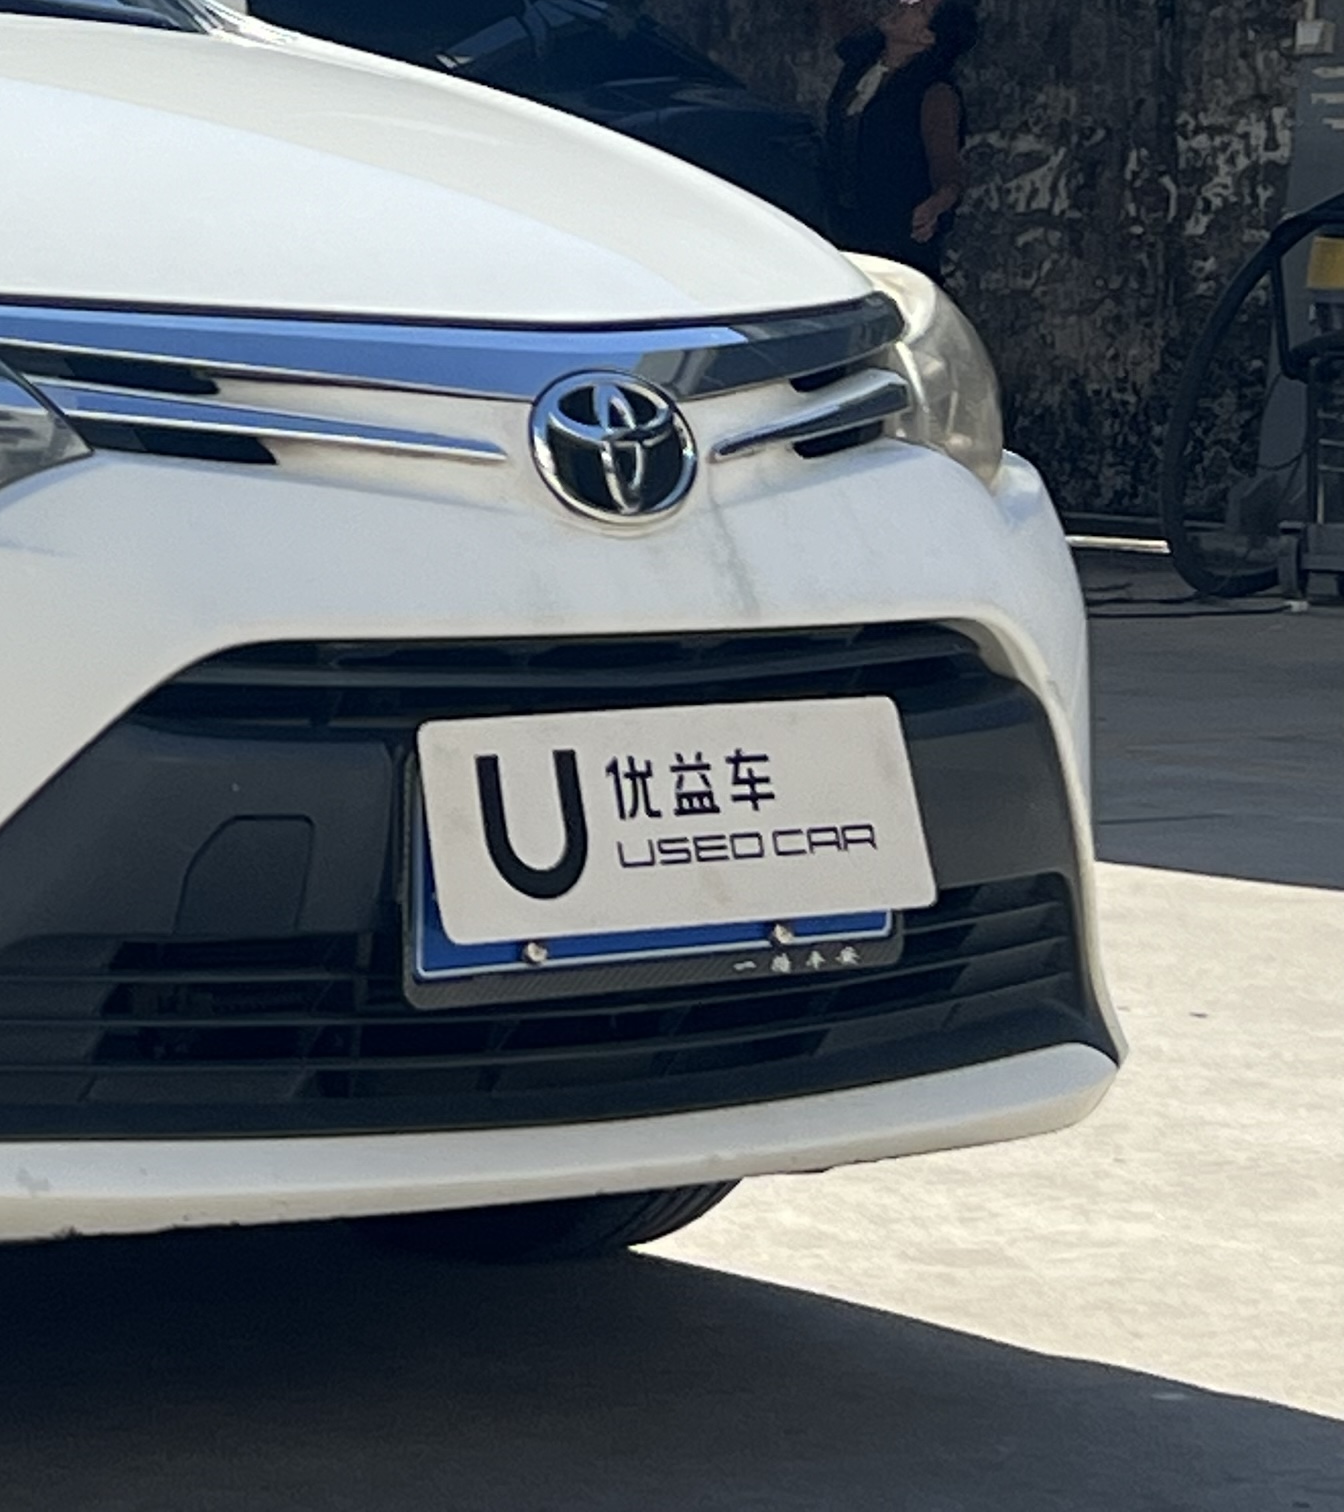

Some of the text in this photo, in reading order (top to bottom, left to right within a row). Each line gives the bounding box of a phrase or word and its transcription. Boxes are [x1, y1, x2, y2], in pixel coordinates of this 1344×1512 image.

[605, 748, 775, 821] 优益车
[475, 749, 589, 900] U
[617, 824, 877, 868] USED CAR
